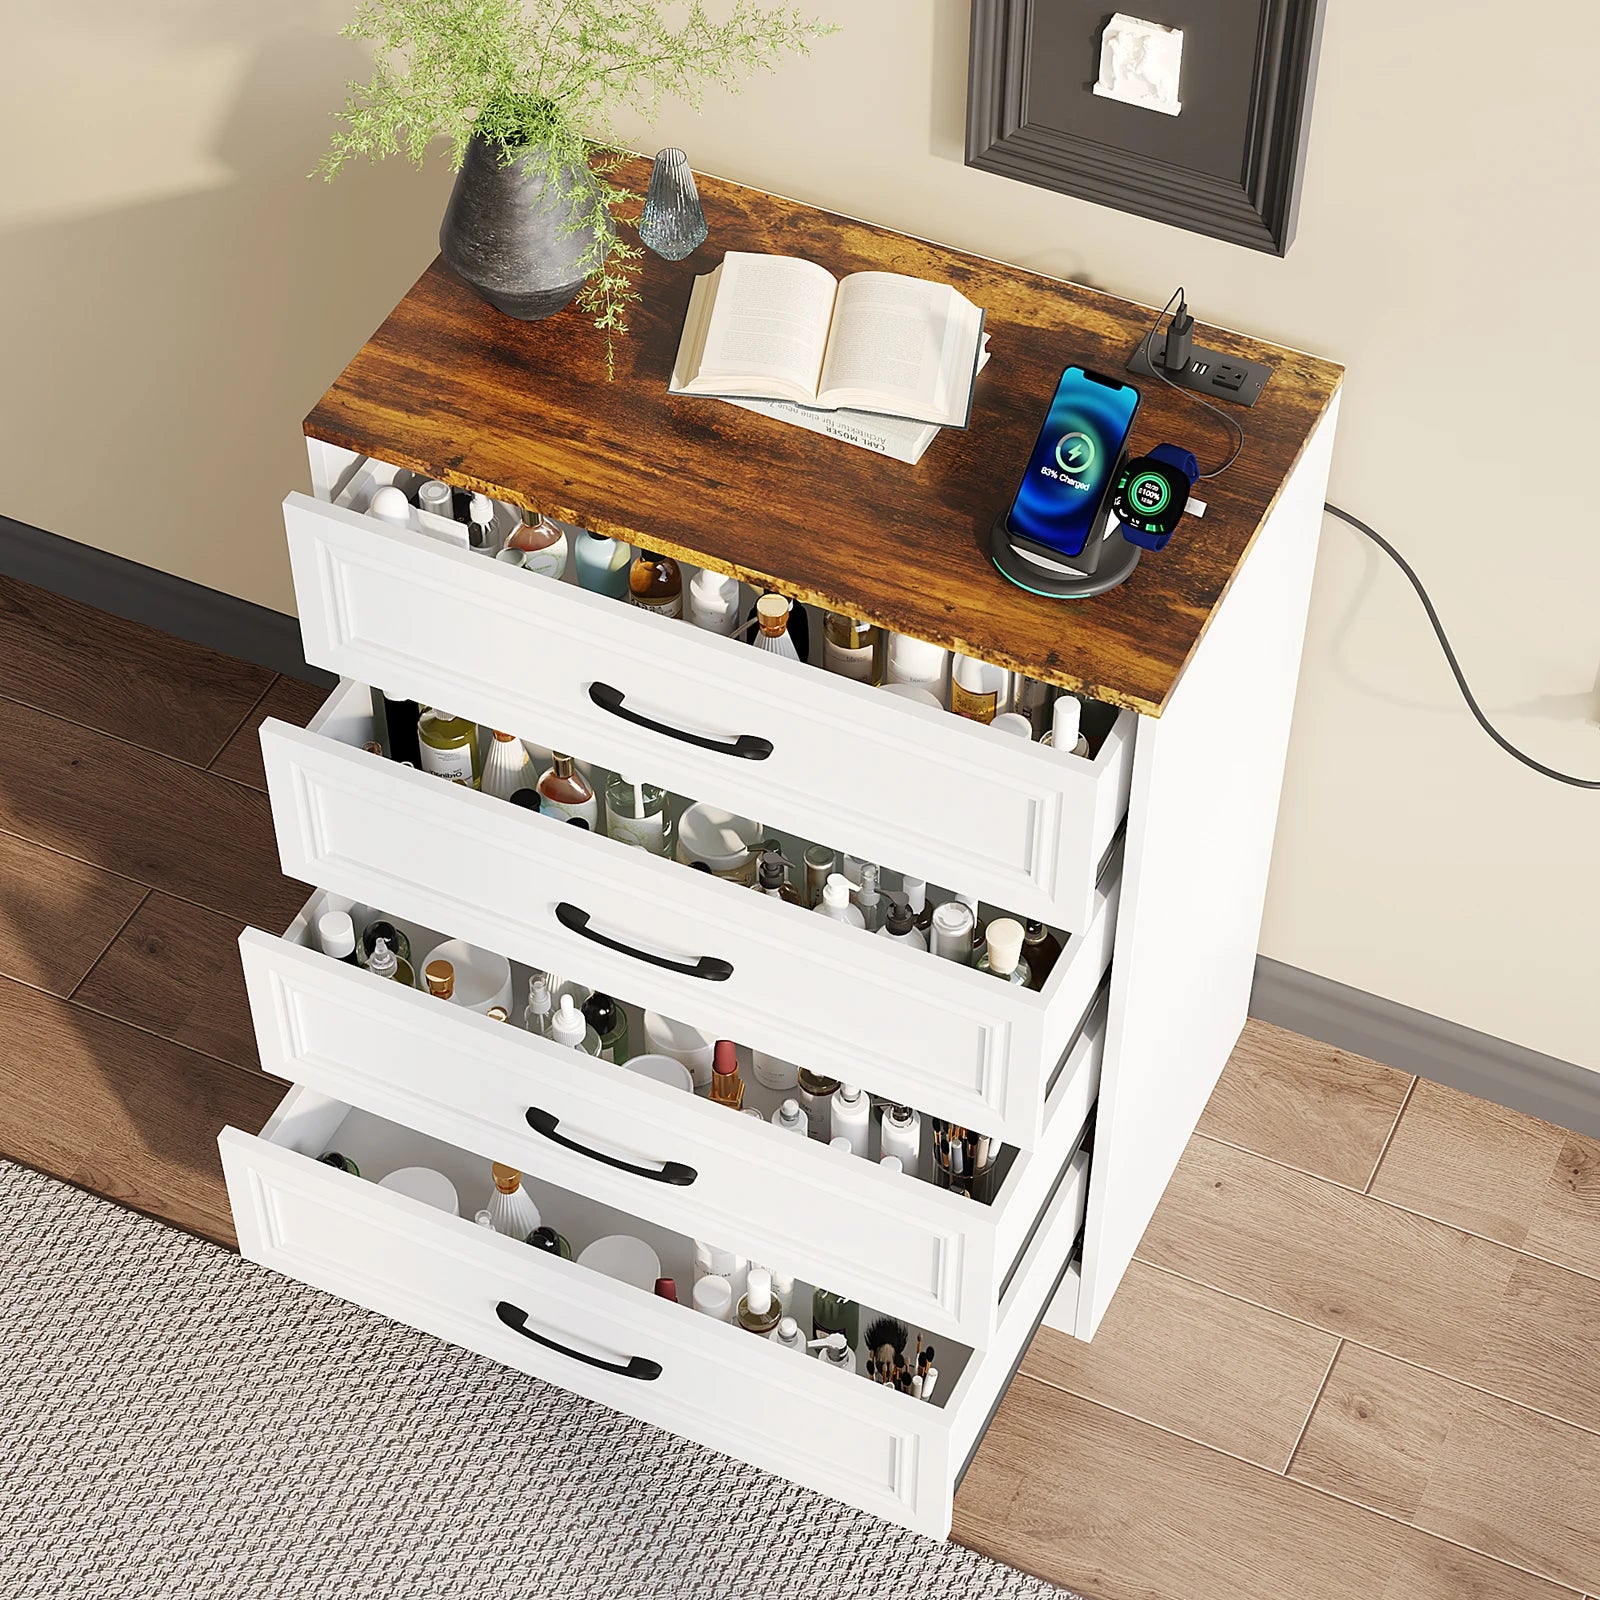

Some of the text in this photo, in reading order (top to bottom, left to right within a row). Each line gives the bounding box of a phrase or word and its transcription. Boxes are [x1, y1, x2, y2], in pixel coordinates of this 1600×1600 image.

[777, 403, 799, 414] neue
[801, 411, 820, 421] eine
[822, 418, 835, 427] für
[826, 426, 886, 452] CARL MOSER
[837, 422, 887, 445] Architektur
[1041, 466, 1090, 491] 83% Charged
[1142, 488, 1160, 501] 100%
